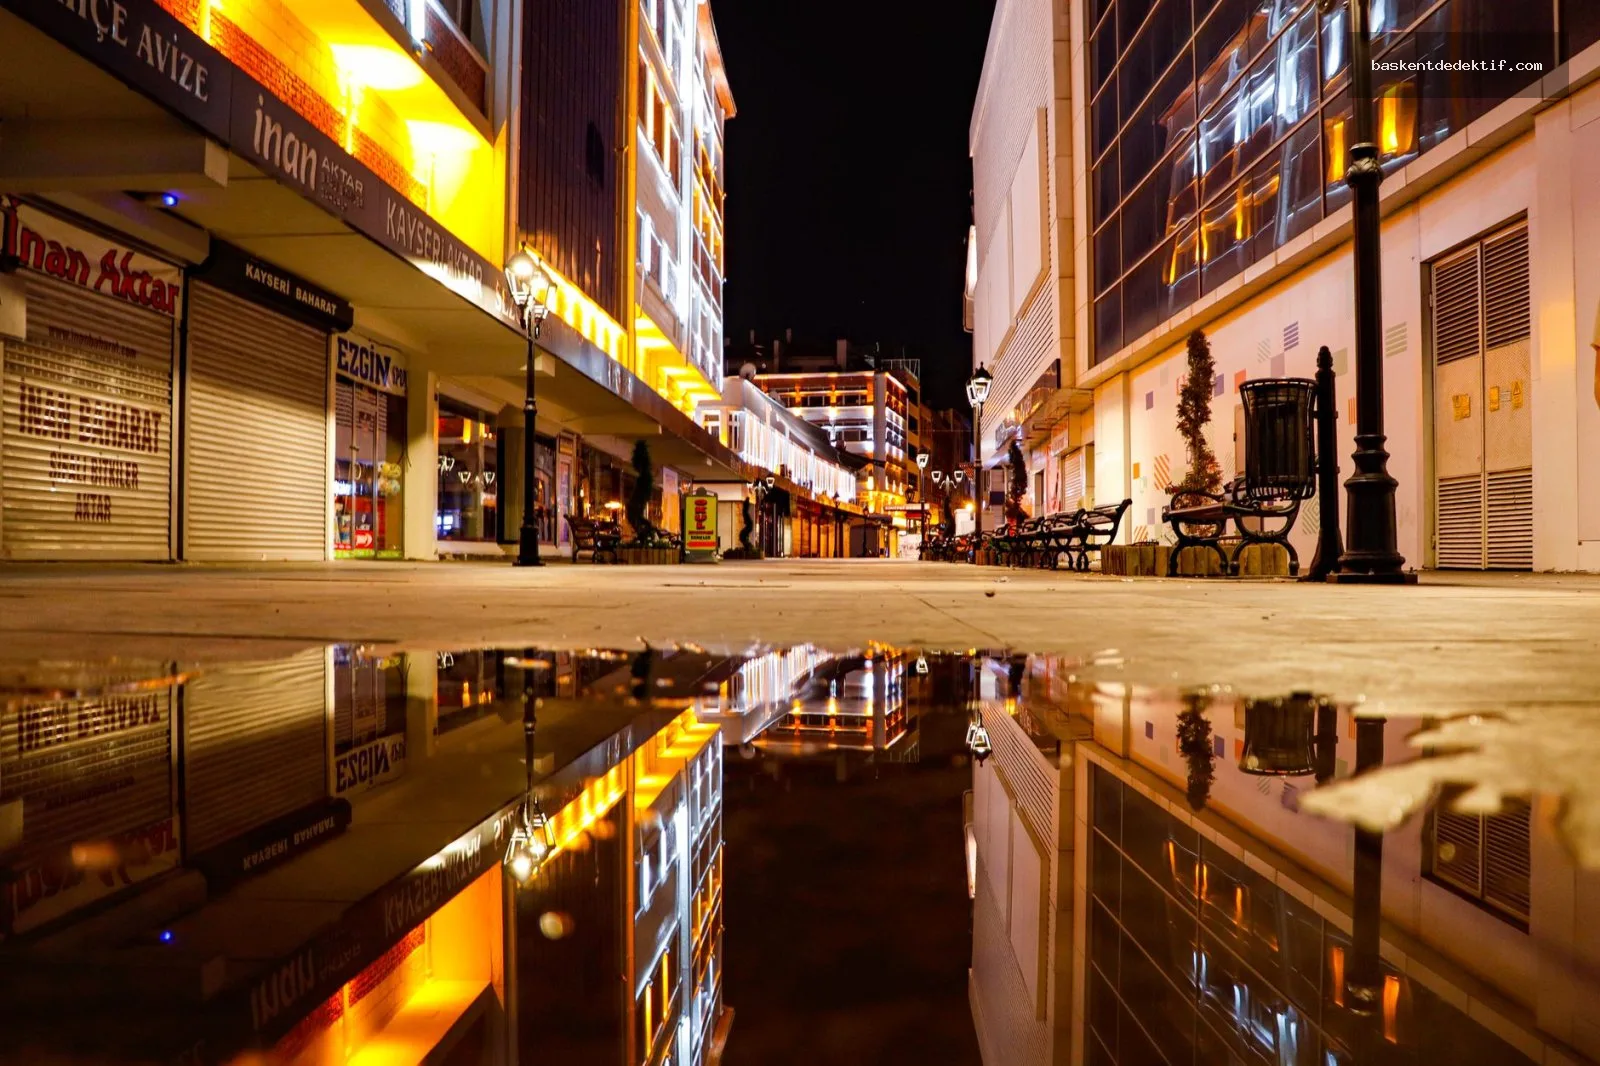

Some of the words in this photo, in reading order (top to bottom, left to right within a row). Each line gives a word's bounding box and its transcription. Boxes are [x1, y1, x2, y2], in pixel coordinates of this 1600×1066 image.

[136, 24, 209, 102] AVİZE
[321, 156, 364, 194] AKTAR
[95, 249, 181, 315] Aktar
[245, 263, 290, 296] KAYSERİ
[295, 287, 337, 316] BAHARAT
[336, 336, 391, 387] EZGİN
[78, 396, 162, 453] BAHARAT
[74, 492, 112, 523] AKTAR
